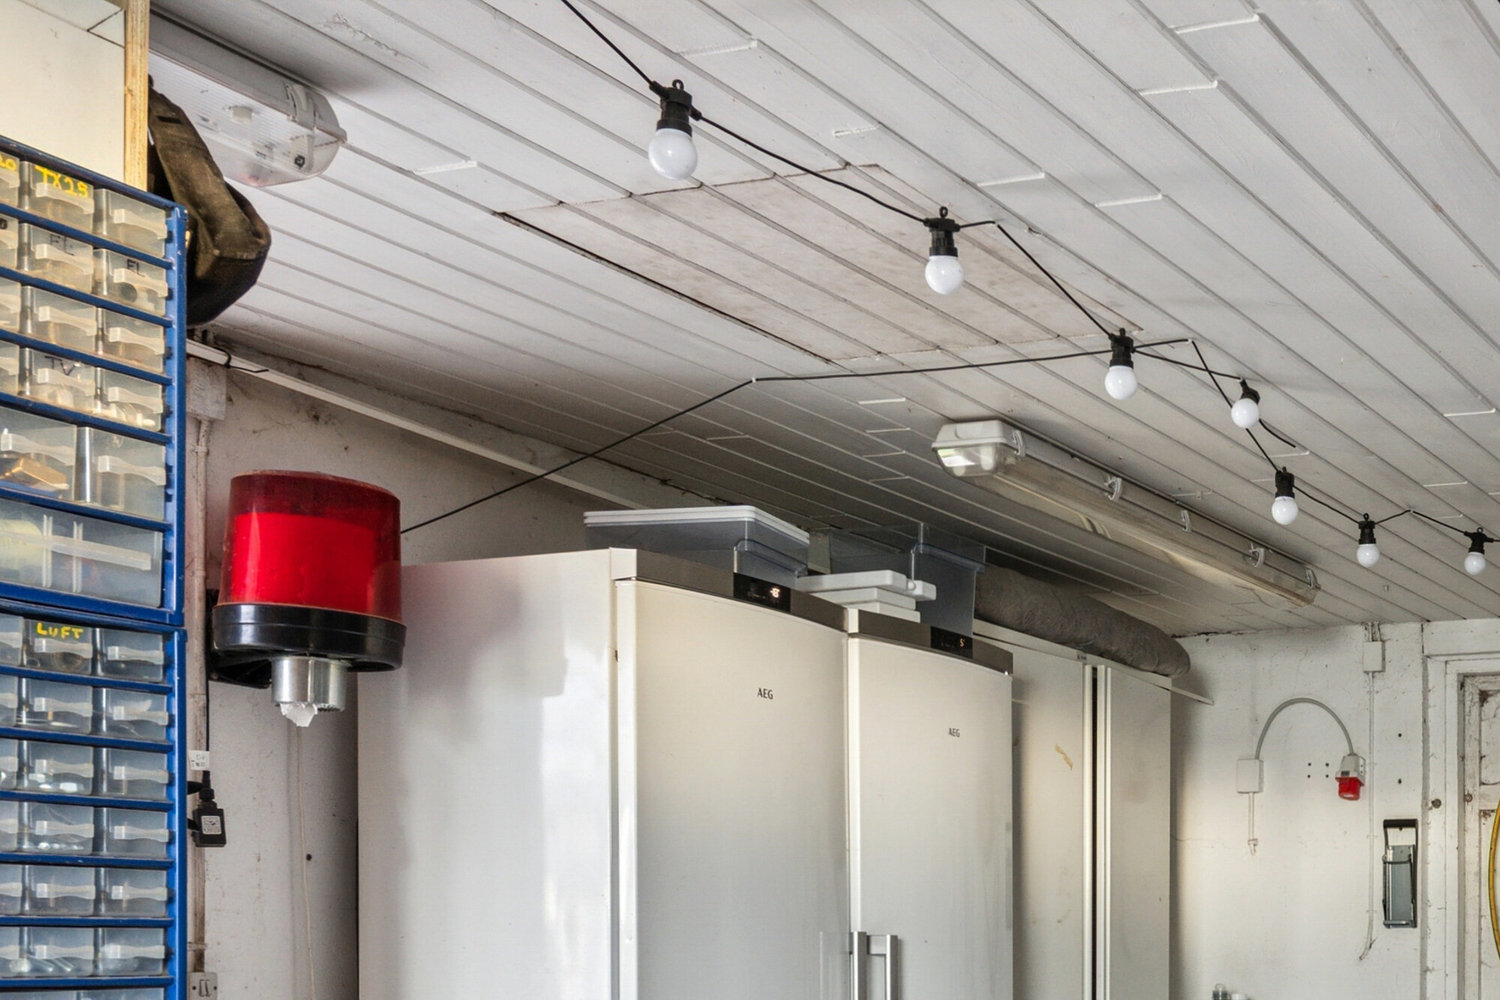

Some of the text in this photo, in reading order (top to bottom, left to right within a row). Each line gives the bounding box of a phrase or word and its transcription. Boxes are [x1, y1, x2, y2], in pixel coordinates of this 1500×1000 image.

[36, 621, 84, 640] LUFT
[757, 687, 774, 700] AEG
[948, 727, 961, 738] AEG
